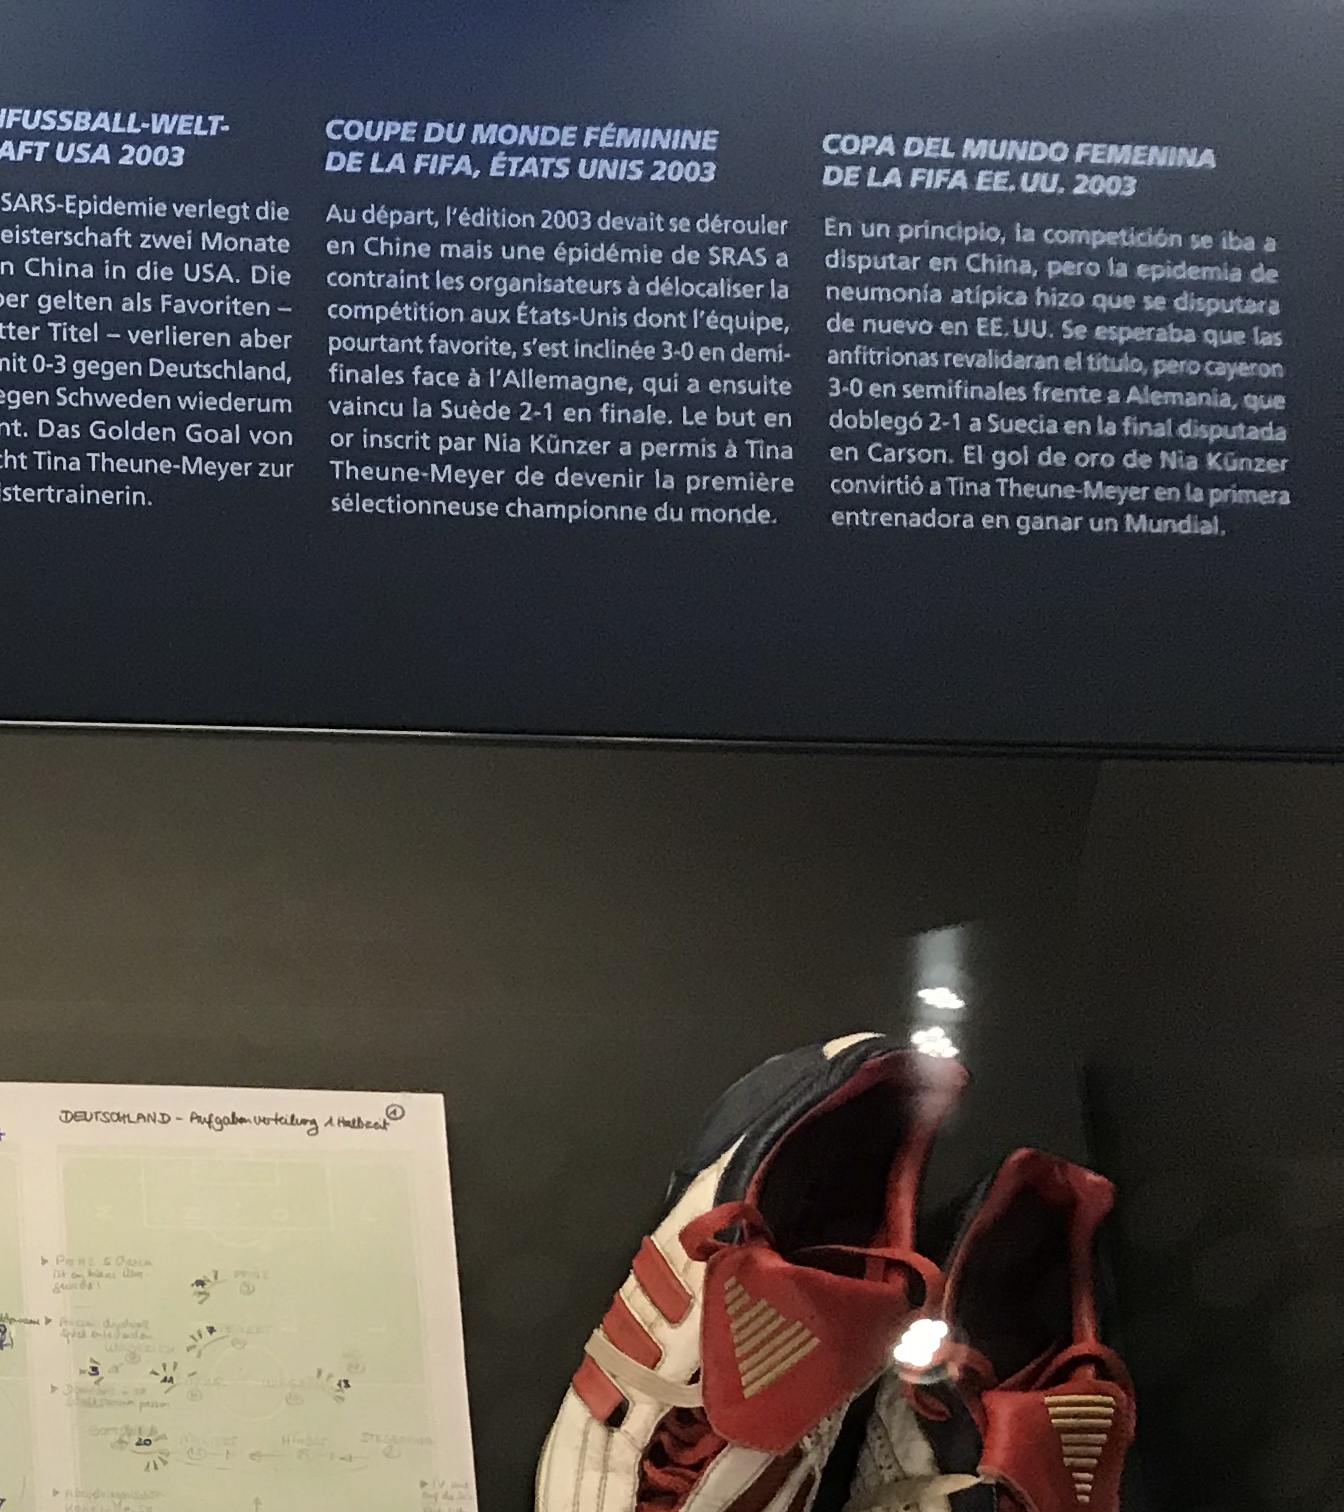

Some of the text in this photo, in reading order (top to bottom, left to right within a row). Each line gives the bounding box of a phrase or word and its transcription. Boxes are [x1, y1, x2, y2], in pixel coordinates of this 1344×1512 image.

[324, 118, 719, 151] COUPE DU MONDE FÉMININE
[821, 132, 1216, 168] COPA DEL MUNDO FEMENINA
[54, 141, 110, 164] USA
[117, 143, 185, 167] 2003
[324, 150, 716, 182] DE LA FIFA, ÉTATS UNIS 2003
[821, 164, 862, 186] DE
[866, 165, 902, 189] LA
[909, 167, 968, 190] FIFA
[1071, 173, 1137, 196] 2003
